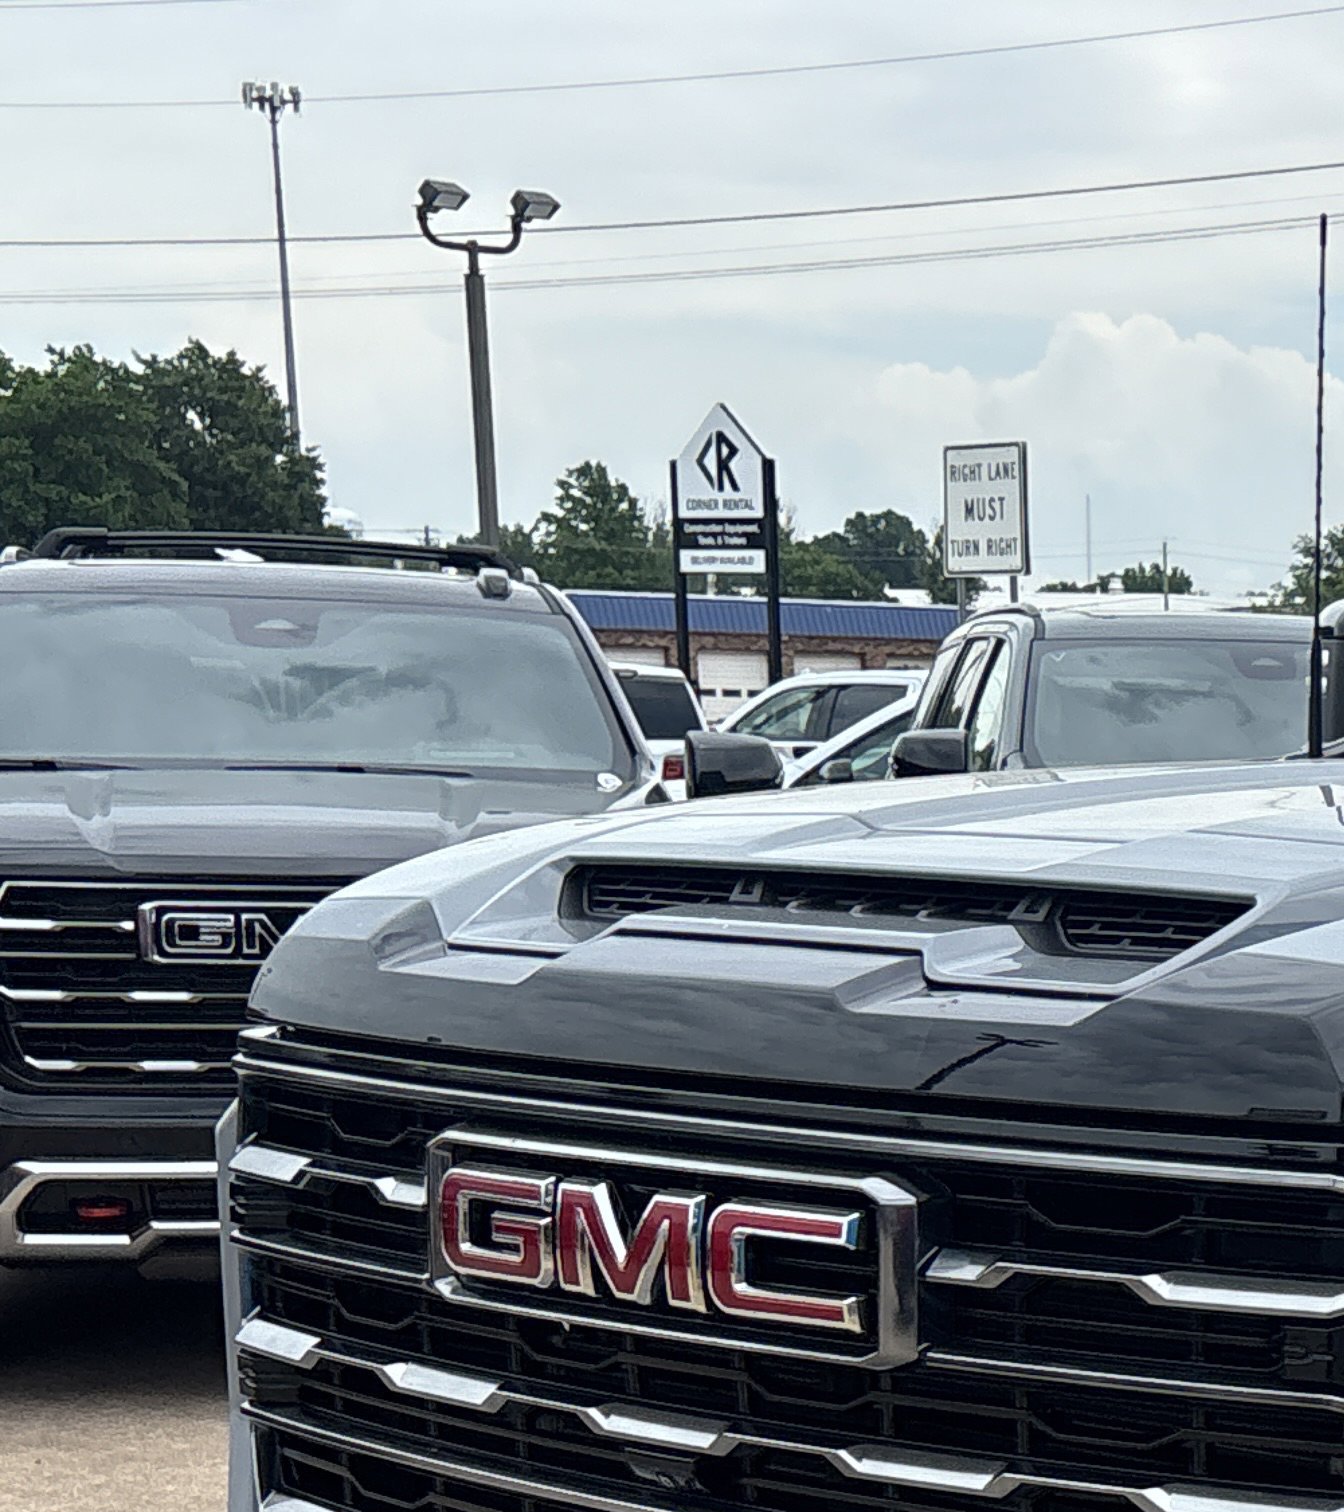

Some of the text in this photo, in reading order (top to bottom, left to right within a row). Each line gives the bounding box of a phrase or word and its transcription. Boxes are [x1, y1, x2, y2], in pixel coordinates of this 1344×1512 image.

[949, 462, 1017, 482] RIGHT LANE
[686, 497, 755, 511] CORNER RENTAL
[964, 496, 1005, 522] MUST
[950, 537, 1018, 557] TURN RIGHT
[440, 1166, 866, 1335] GMC
